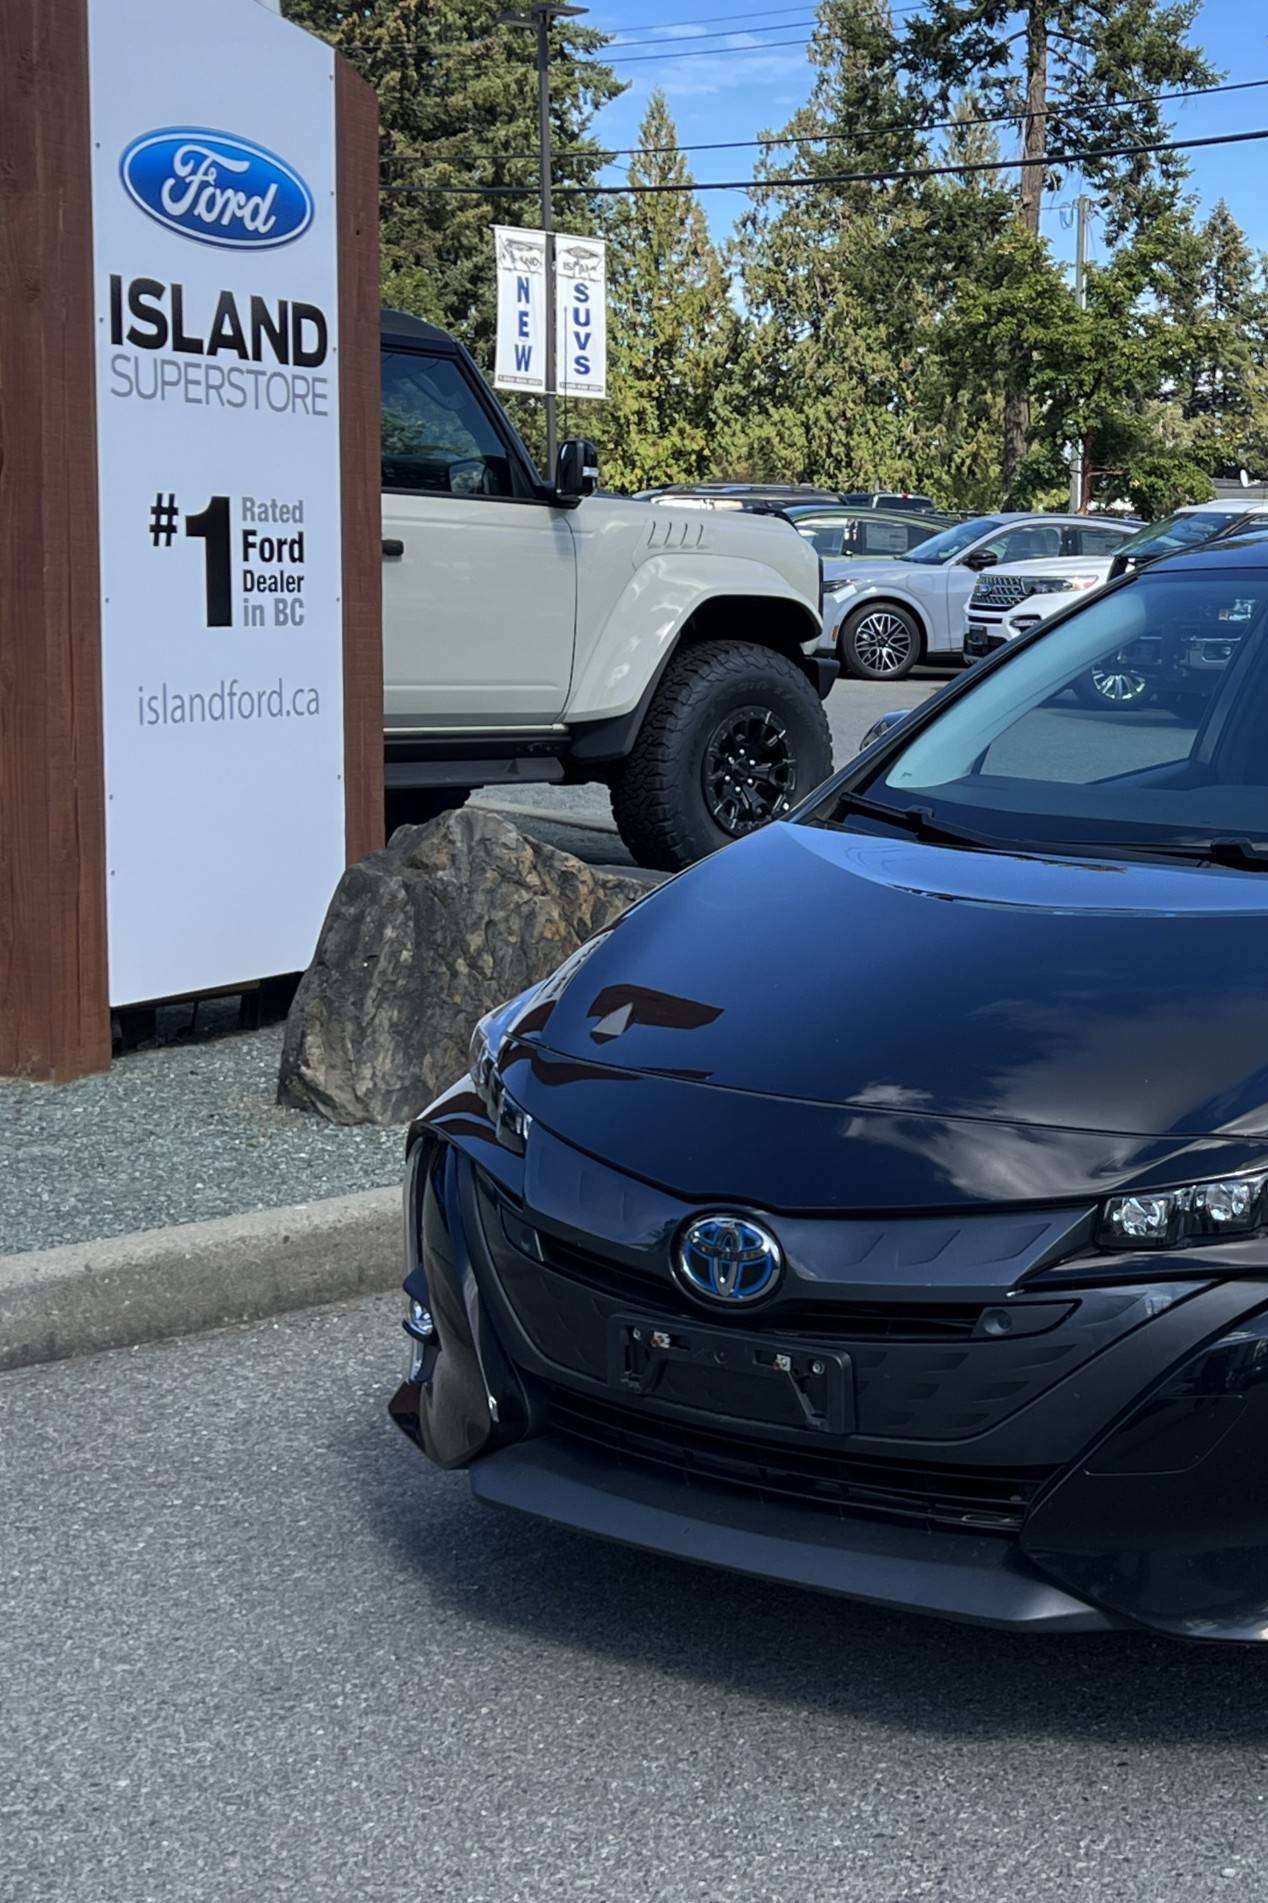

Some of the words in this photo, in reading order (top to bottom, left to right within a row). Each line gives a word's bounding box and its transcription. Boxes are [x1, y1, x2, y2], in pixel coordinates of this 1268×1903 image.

[161, 144, 278, 234] Ford
[109, 273, 328, 368] ISLAND
[514, 276, 532, 373] NEW
[573, 283, 591, 375] SUVS
[110, 353, 329, 417] SUPERSTORE
[241, 496, 304, 524] Rated
[242, 529, 305, 563] Ford
[242, 568, 305, 593] Dealer
[243, 598, 265, 627] in
[274, 598, 305, 627] BC
[138, 677, 320, 726] islandford.ca
